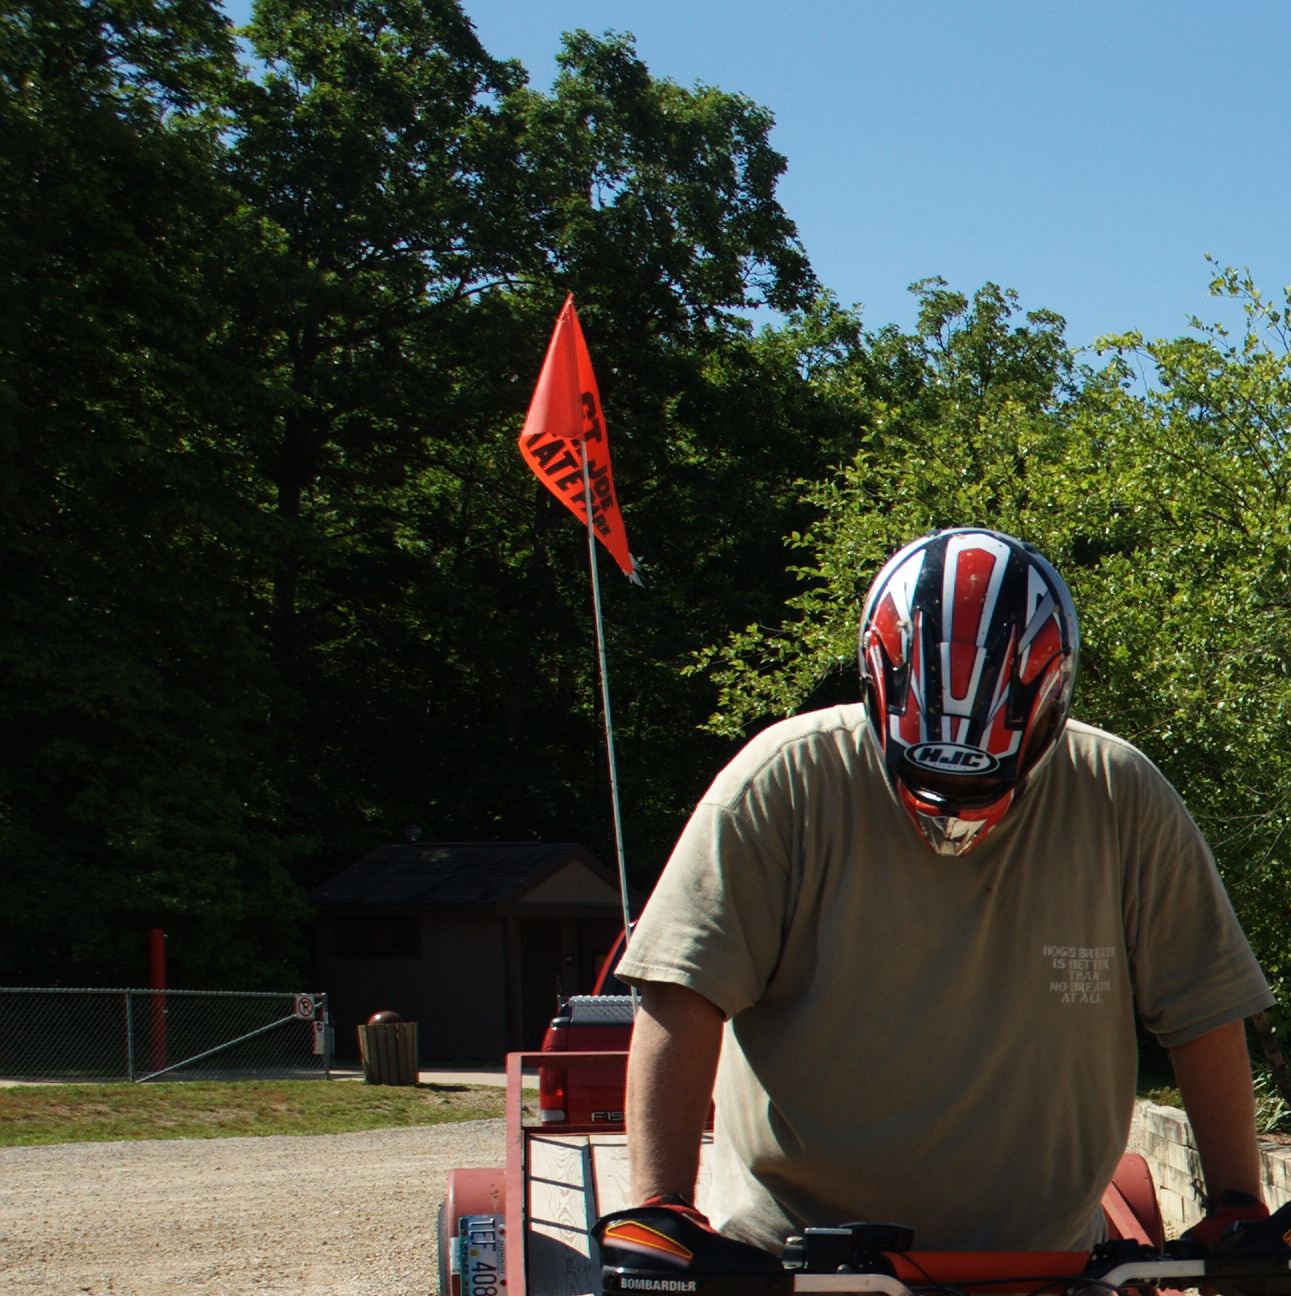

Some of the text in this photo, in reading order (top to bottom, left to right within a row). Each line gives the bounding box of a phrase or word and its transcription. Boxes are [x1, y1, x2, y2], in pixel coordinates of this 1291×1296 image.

[918, 747, 985, 768] HJC
[1053, 958, 1110, 970] IS BETTER
[1069, 970, 1101, 981] THAN
[1049, 981, 1068, 992] NO
[1061, 993, 1105, 1003] AT ALL
[467, 1217, 497, 1252] TEF
[620, 1277, 697, 1292] BOMBARDIER
